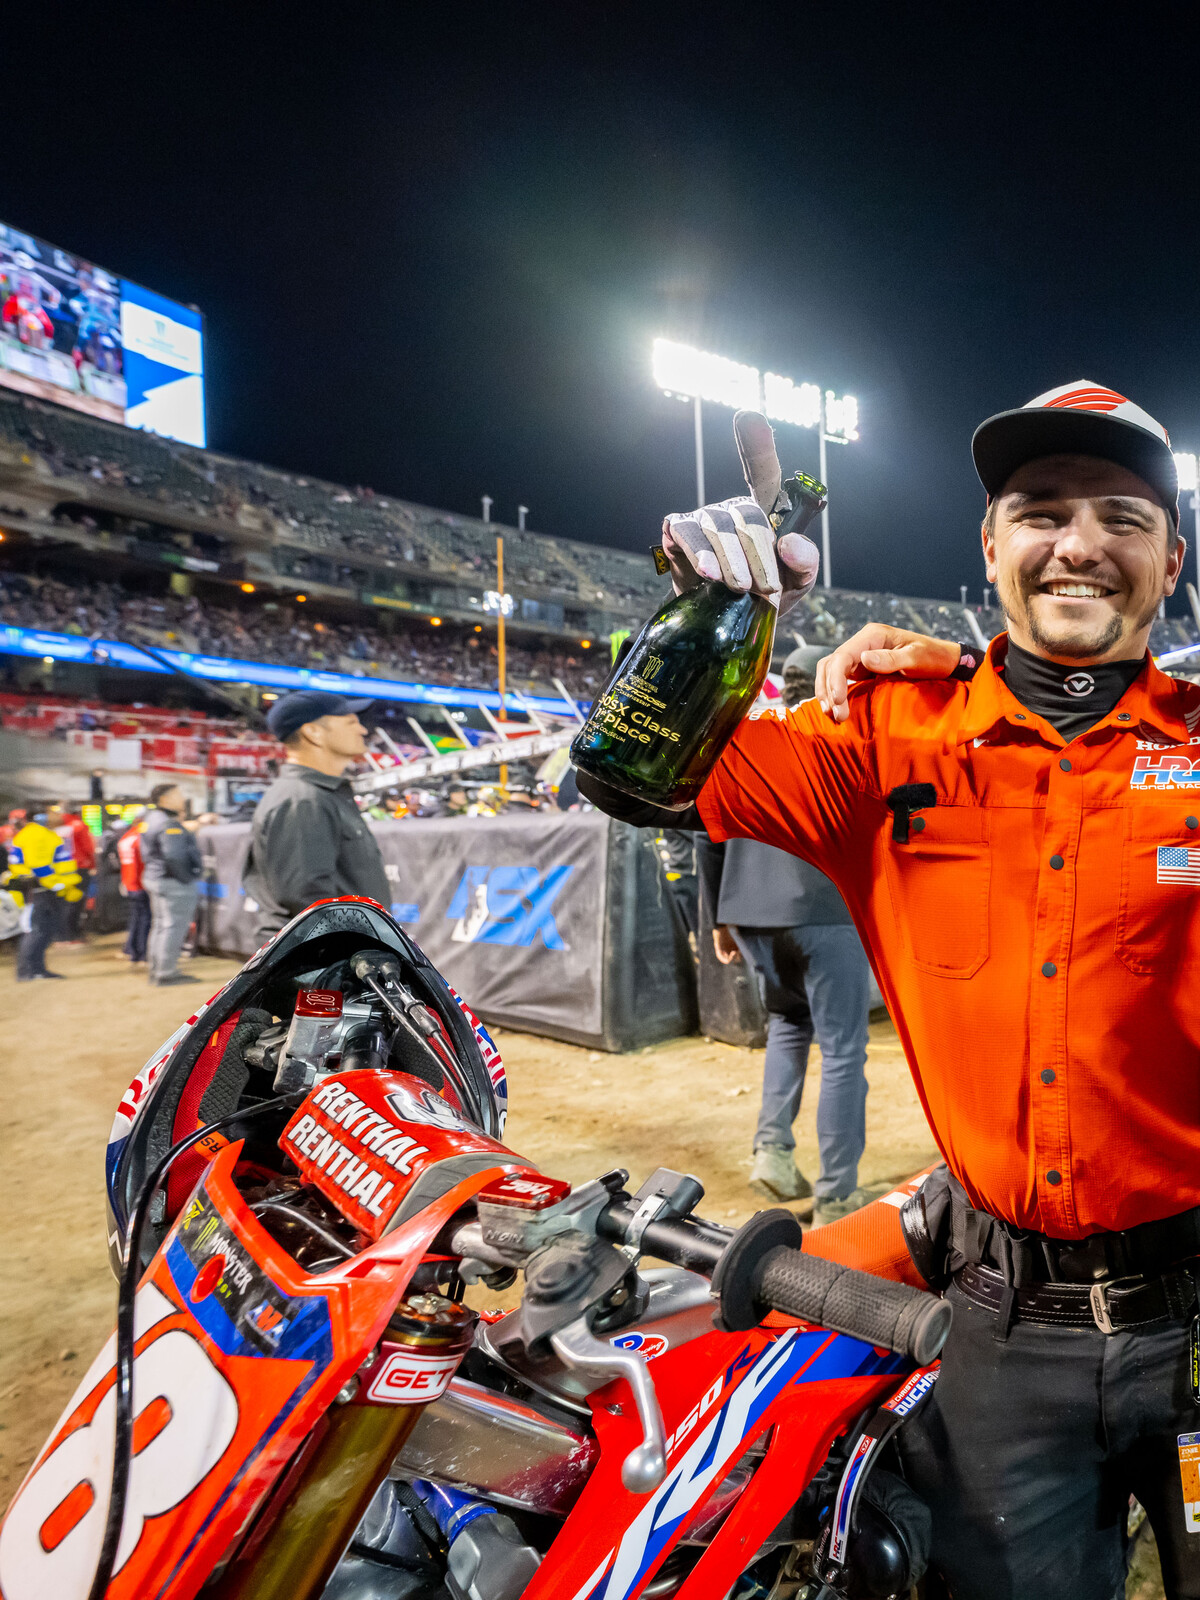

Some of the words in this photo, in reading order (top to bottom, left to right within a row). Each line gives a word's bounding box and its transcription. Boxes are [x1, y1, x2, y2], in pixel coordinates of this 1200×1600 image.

[603, 713, 651, 744] Place
[630, 711, 681, 742] Class
[312, 1081, 430, 1176] RENTHAL
[287, 1113, 395, 1218] RENTHAL
[210, 1232, 253, 1296] MONSTER
[386, 1368, 454, 1389] GET
[894, 1373, 921, 1402] CHRISTIEN
